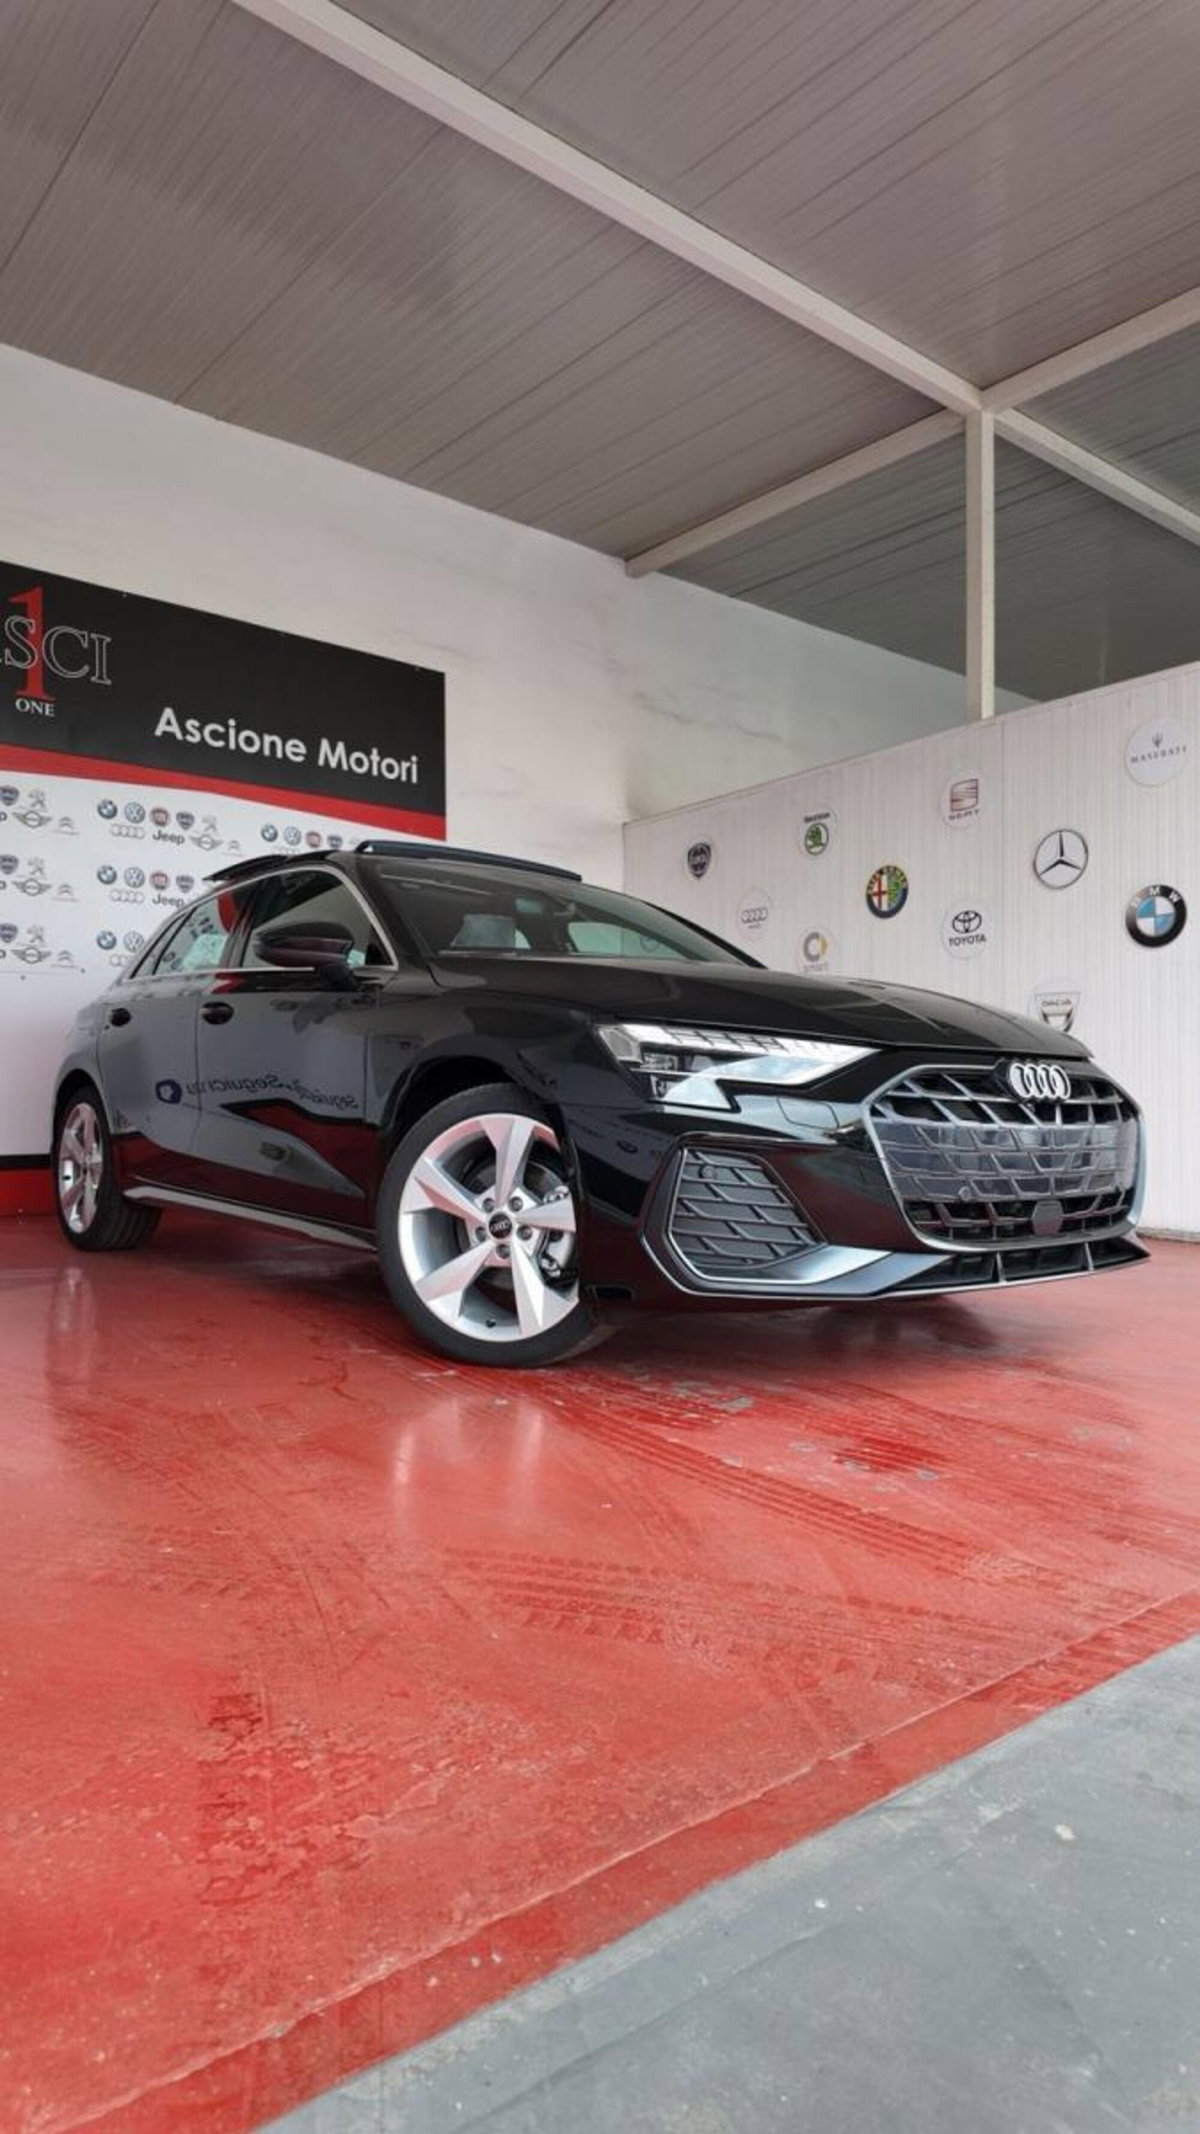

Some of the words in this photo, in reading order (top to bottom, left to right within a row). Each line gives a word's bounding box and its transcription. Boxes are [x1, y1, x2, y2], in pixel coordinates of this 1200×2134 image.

[0, 614, 112, 685] SCI
[15, 698, 55, 717] ONE
[154, 707, 307, 762] Ascione
[318, 737, 418, 784] Motori
[152, 830, 186, 845] Jeep
[152, 894, 185, 908] Jeep
[949, 934, 986, 947] TOYOTA
